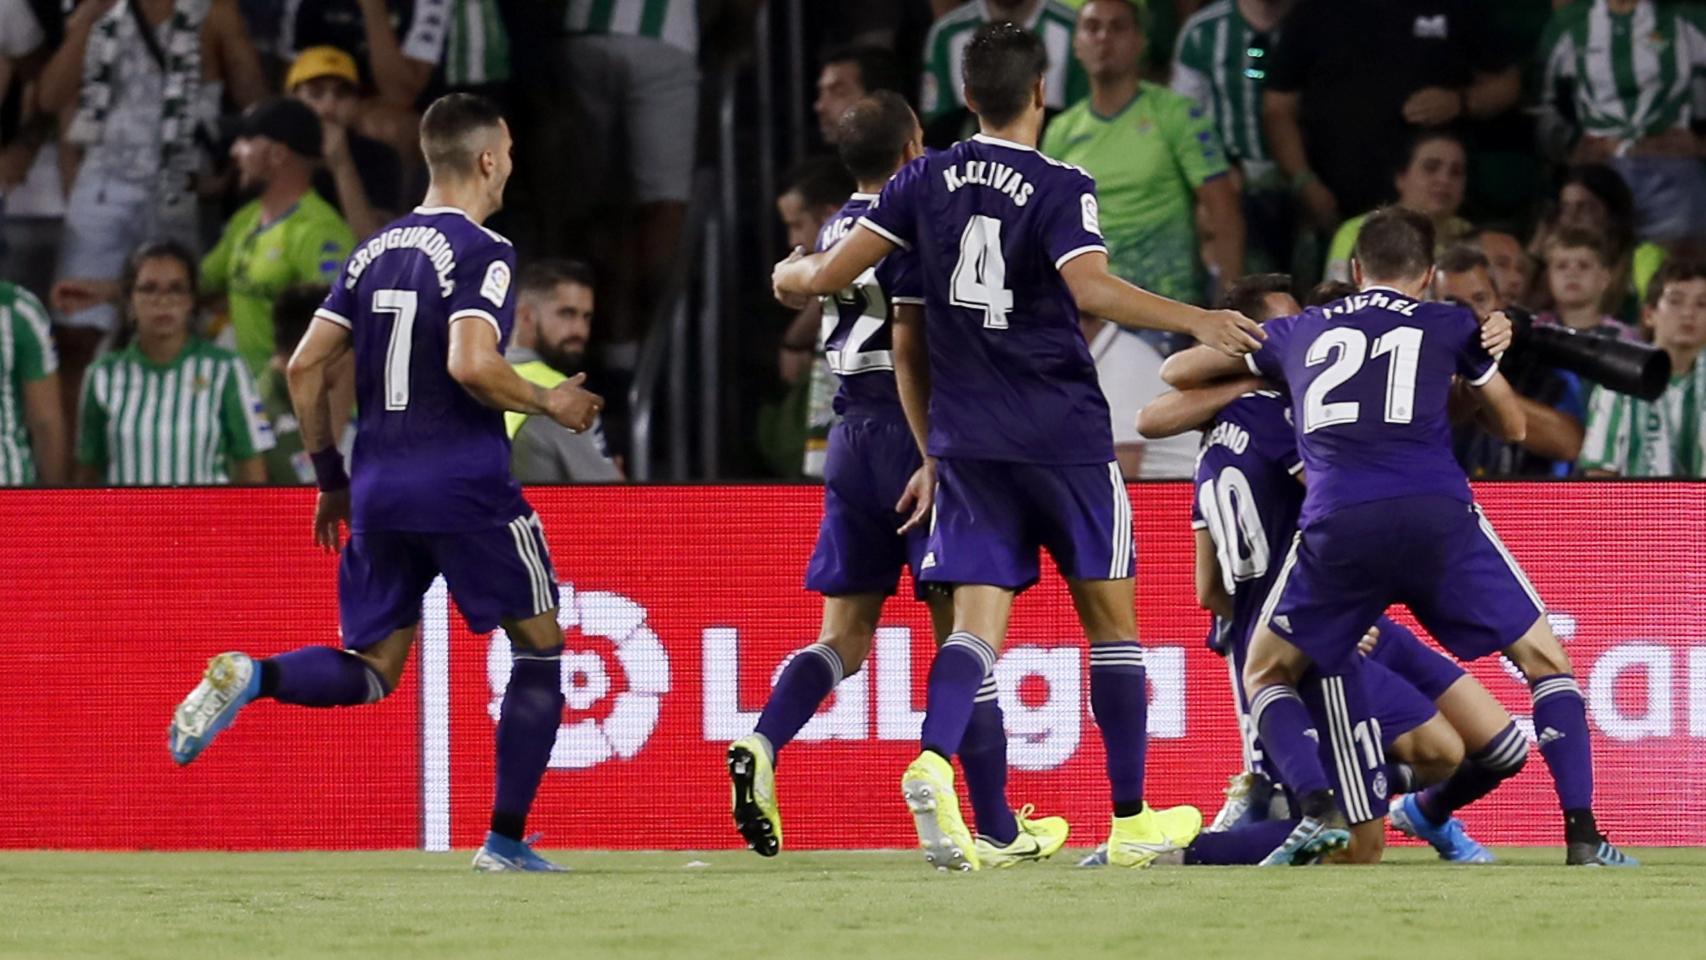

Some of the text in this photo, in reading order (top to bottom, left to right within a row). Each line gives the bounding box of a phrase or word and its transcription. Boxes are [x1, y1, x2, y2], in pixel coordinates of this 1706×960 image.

[943, 160, 1035, 207] K.OLIVAS
[949, 214, 1014, 330] 4
[371, 289, 418, 411] 7
[1303, 326, 1424, 434] 21
[1199, 466, 1269, 595] 10
